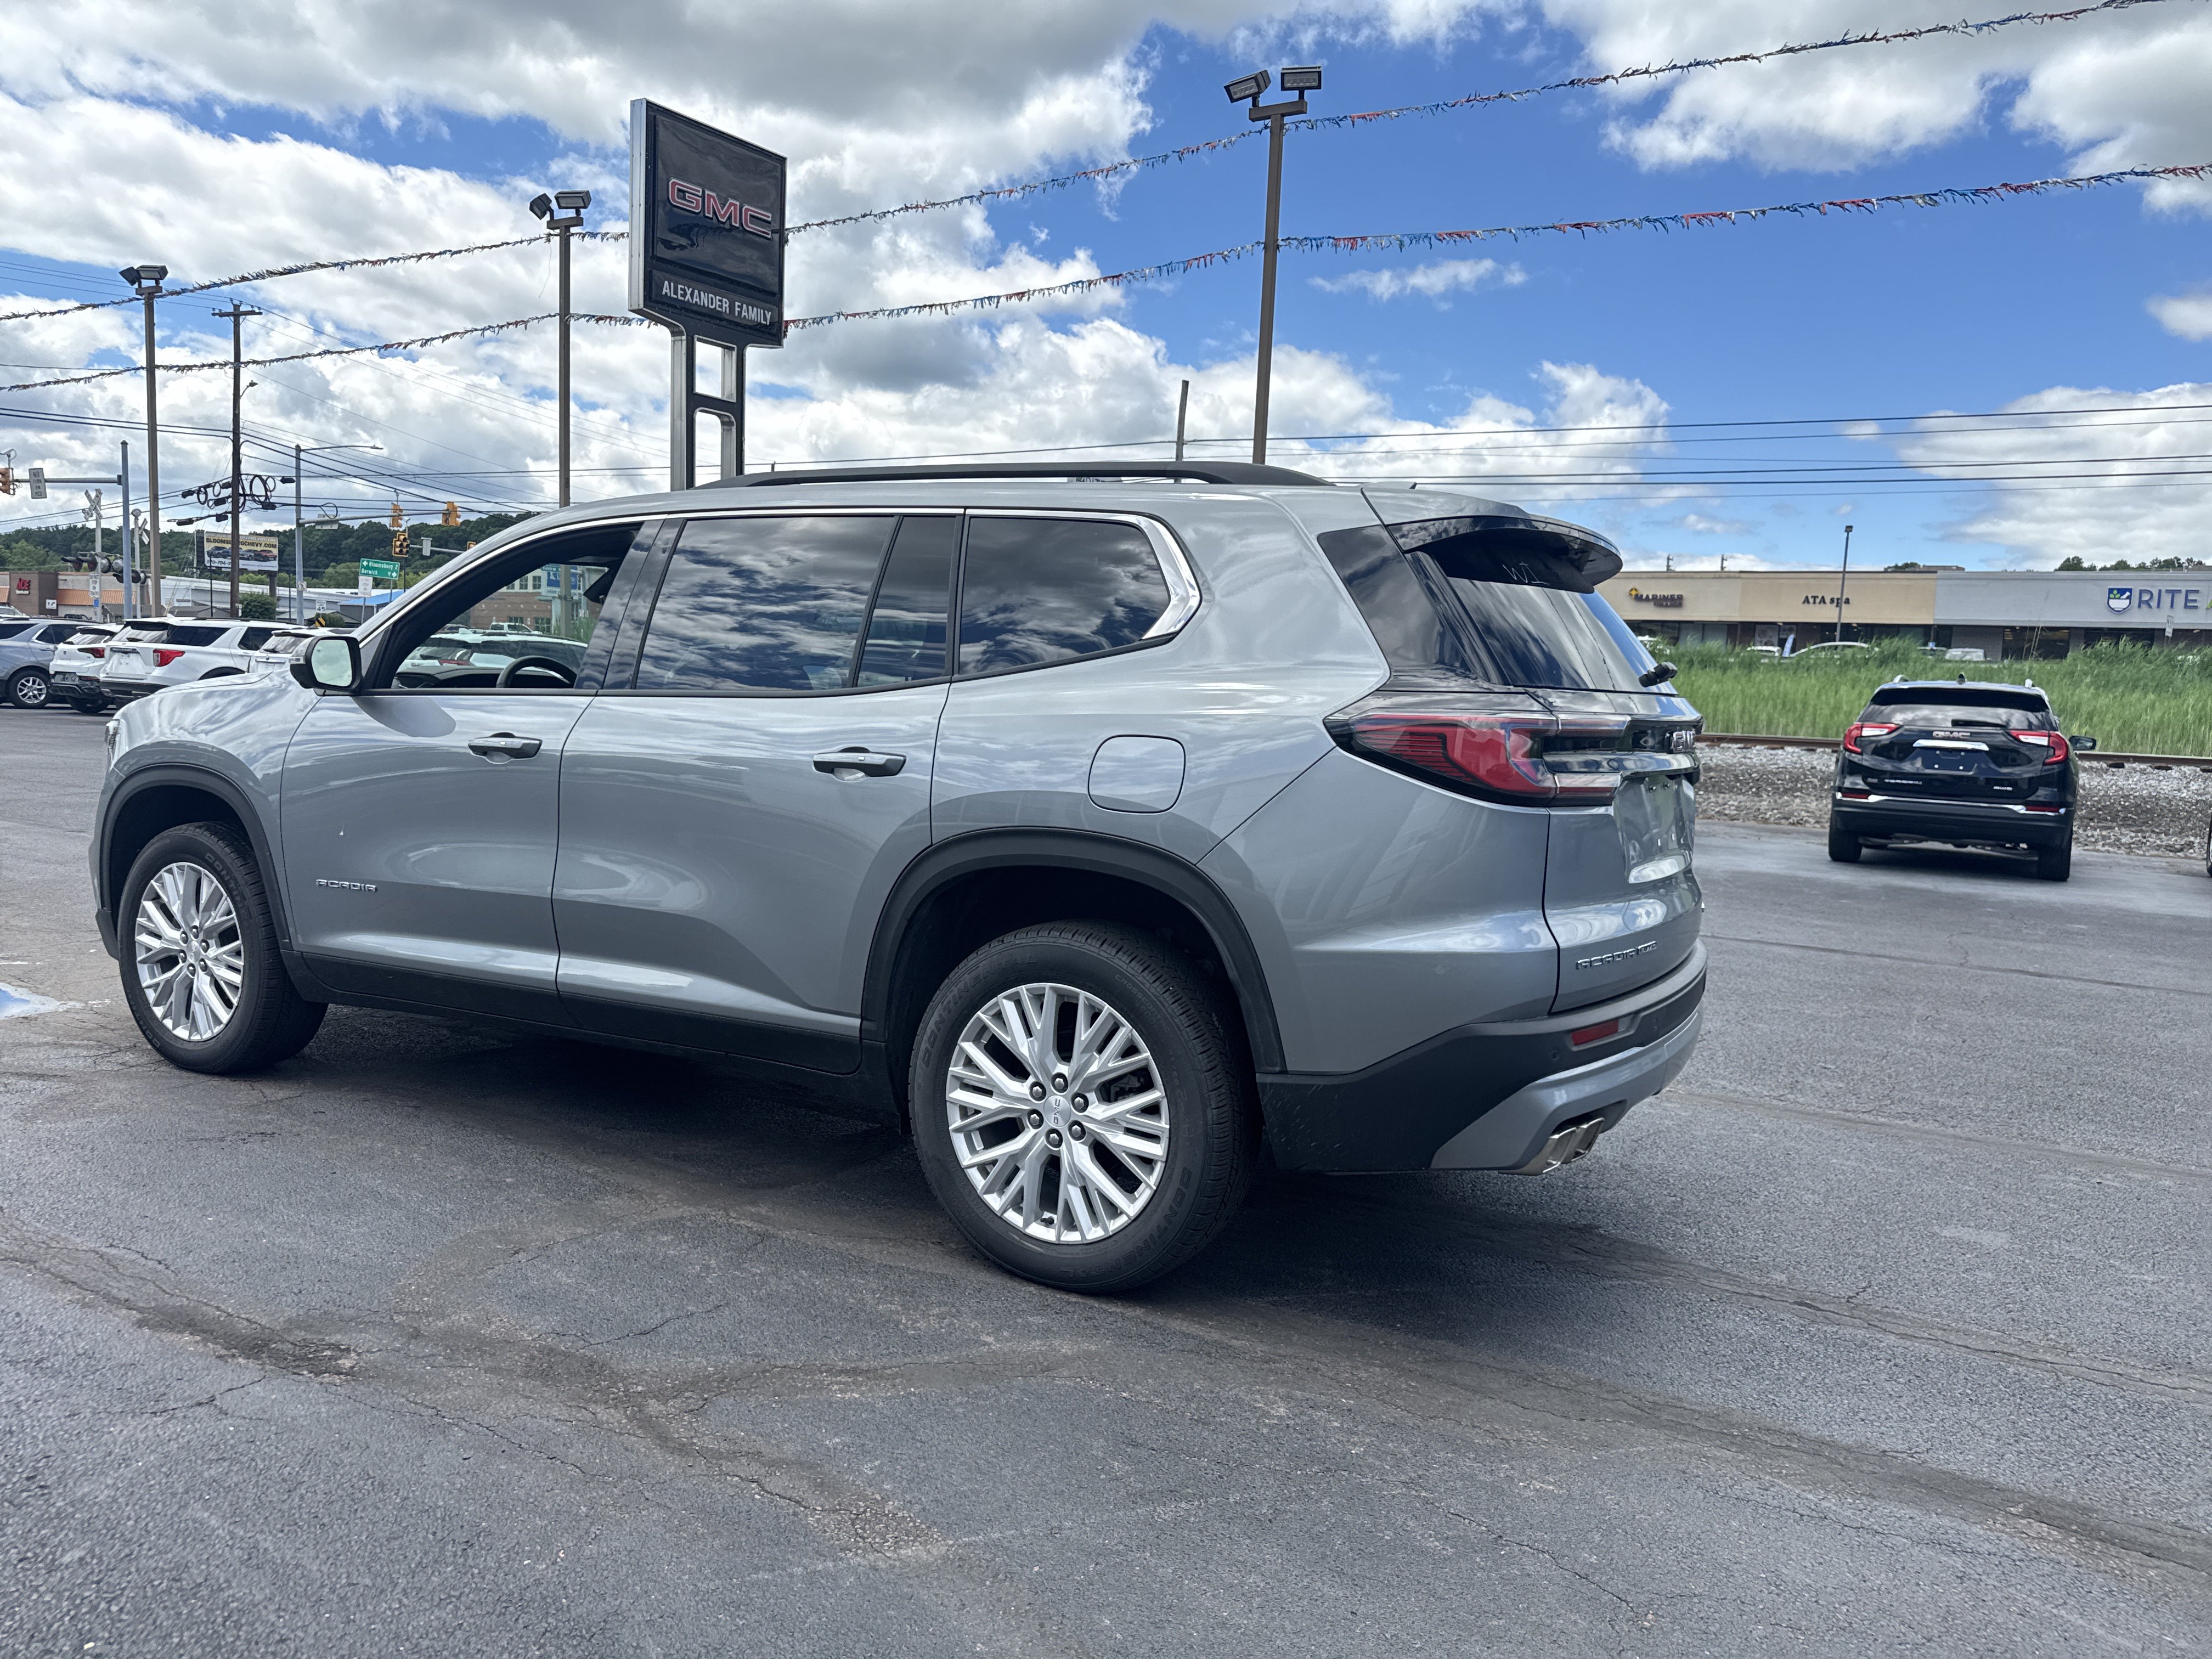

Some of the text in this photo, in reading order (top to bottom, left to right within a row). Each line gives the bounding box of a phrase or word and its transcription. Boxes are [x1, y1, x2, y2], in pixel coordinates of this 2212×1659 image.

[669, 177, 772, 239] GMC
[662, 280, 771, 326] ALEXANDER FAMILY
[1634, 594, 1683, 602] MARINER
[1802, 595, 1850, 607] ATA spa
[2137, 589, 2200, 609] RITE
[1932, 730, 1971, 739] GMC
[315, 879, 377, 893] ACADIA
[1576, 948, 1637, 970] ACADIA
[1060, 1166, 1194, 1278] CONTINENTAL
